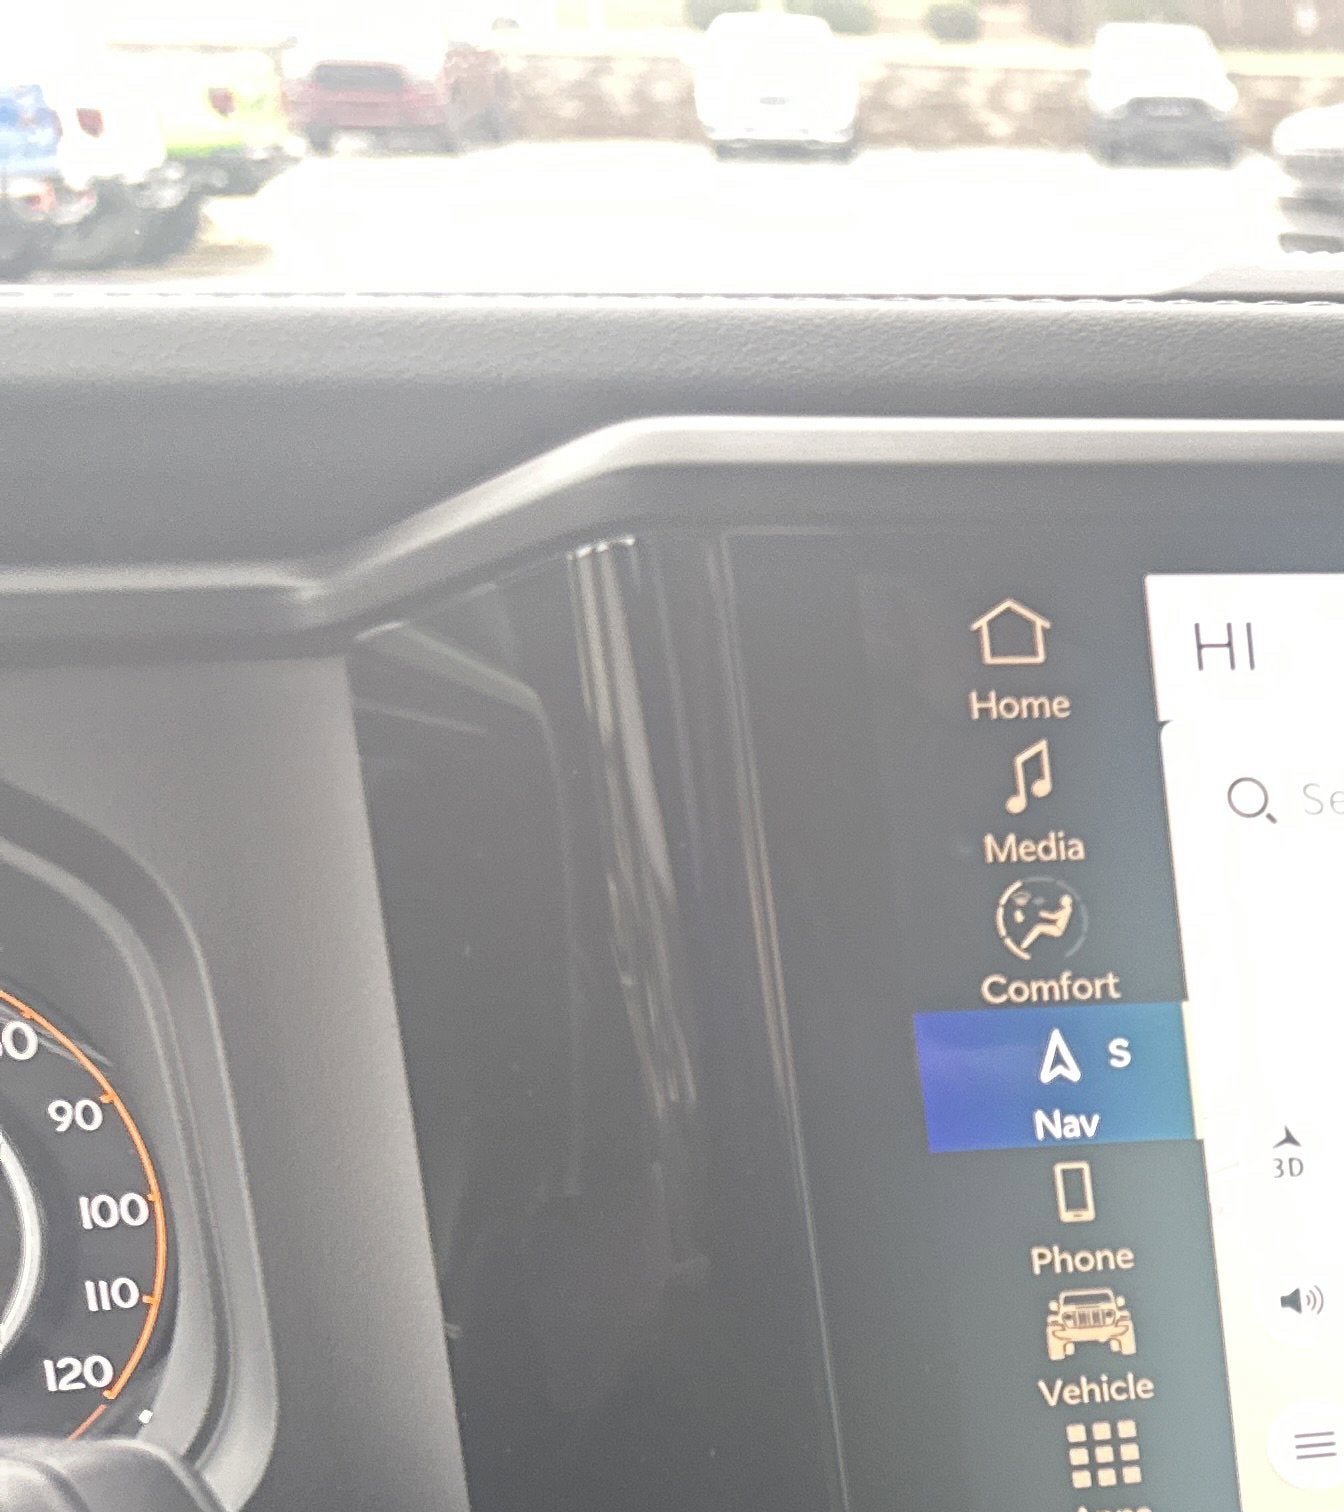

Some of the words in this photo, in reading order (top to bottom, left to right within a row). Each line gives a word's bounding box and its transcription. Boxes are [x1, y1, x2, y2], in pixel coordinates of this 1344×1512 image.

[1194, 622, 1255, 671] HI
[969, 690, 1071, 721] Home
[983, 831, 1085, 865] Media
[981, 972, 1121, 1003] Comfort
[1109, 1037, 1132, 1068] S
[47, 1098, 103, 1132] 90
[1033, 1109, 1100, 1141] Nav
[1272, 1157, 1304, 1179] 3D
[79, 1192, 150, 1230] 100
[1031, 1245, 1135, 1275] Phone
[85, 1277, 140, 1311] 110
[43, 1355, 113, 1392] 120
[1038, 1373, 1154, 1407] Vehicle
